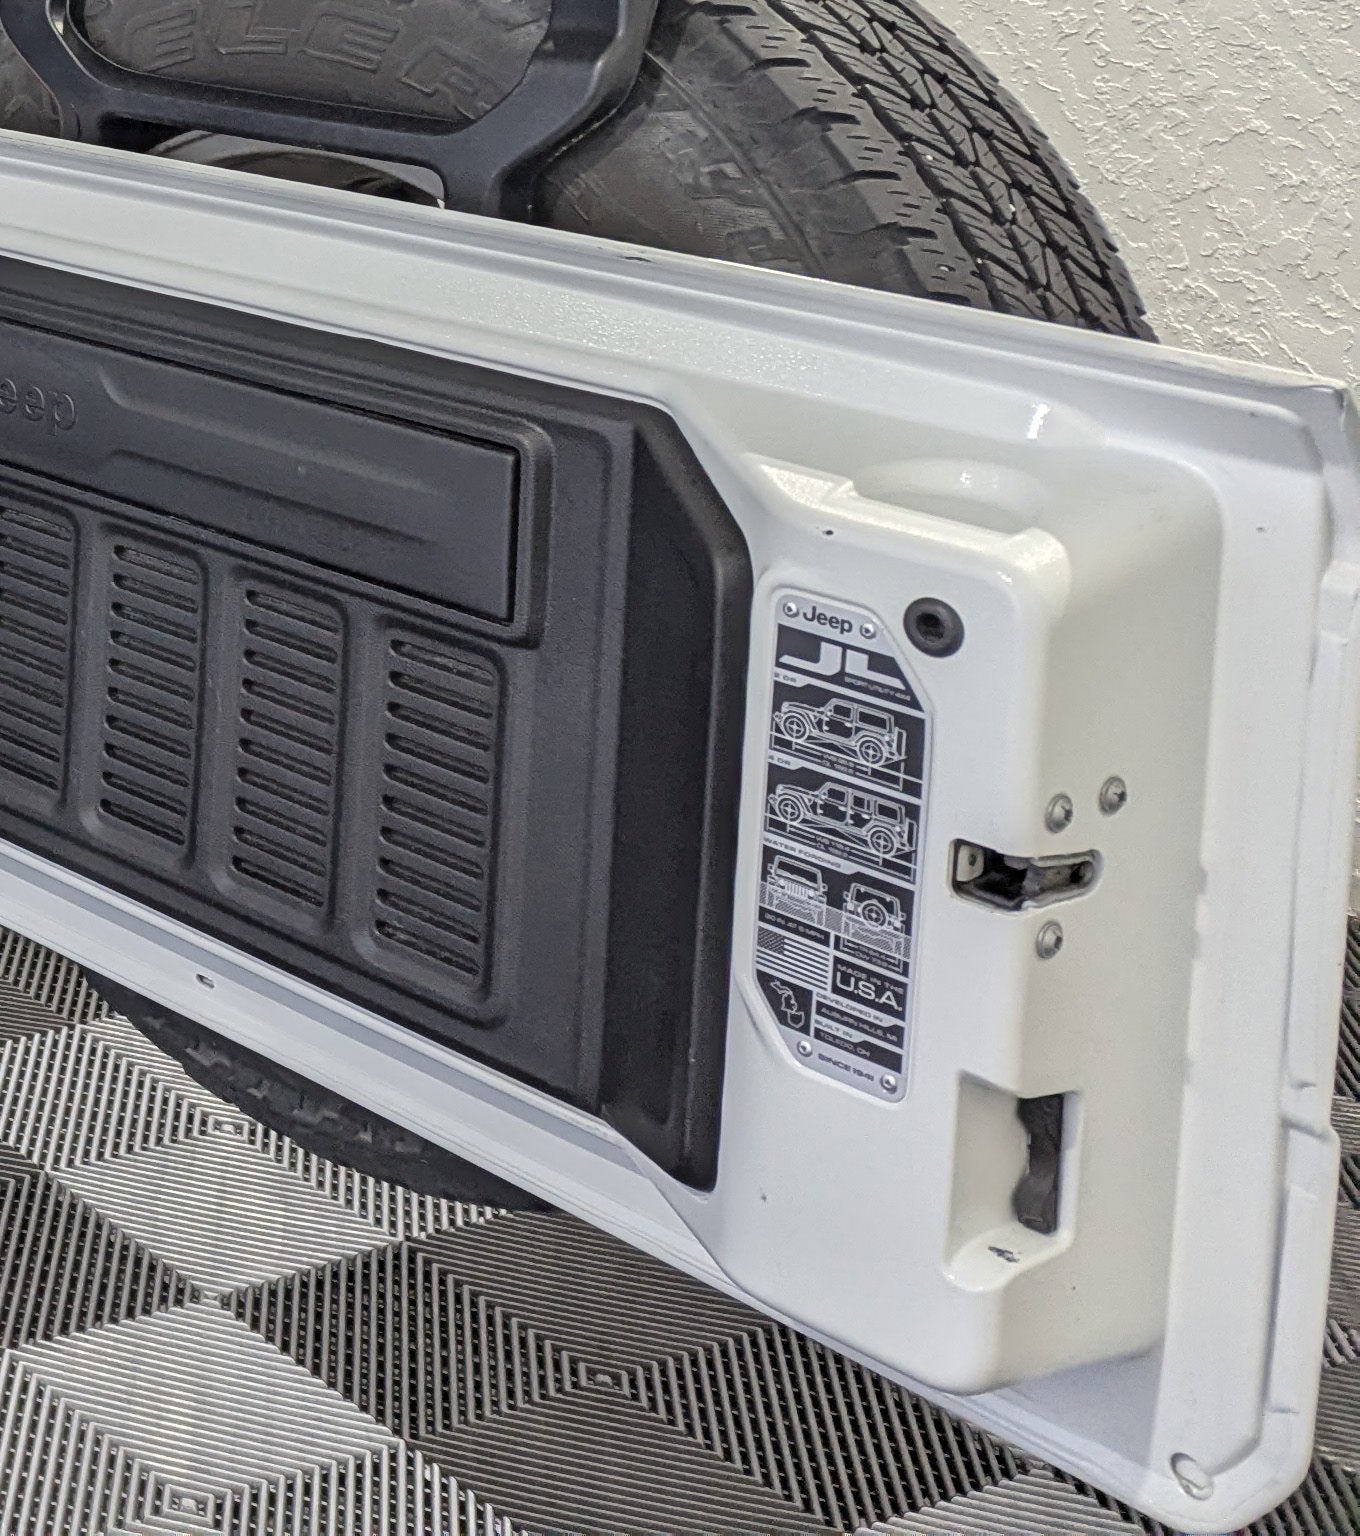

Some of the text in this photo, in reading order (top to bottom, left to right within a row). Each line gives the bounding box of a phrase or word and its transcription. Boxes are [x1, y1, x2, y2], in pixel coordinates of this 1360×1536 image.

[802, 605, 853, 635] Jeep
[779, 641, 907, 690] JL
[837, 964, 867, 981] MADE
[836, 971, 903, 1011] U.S.A.
